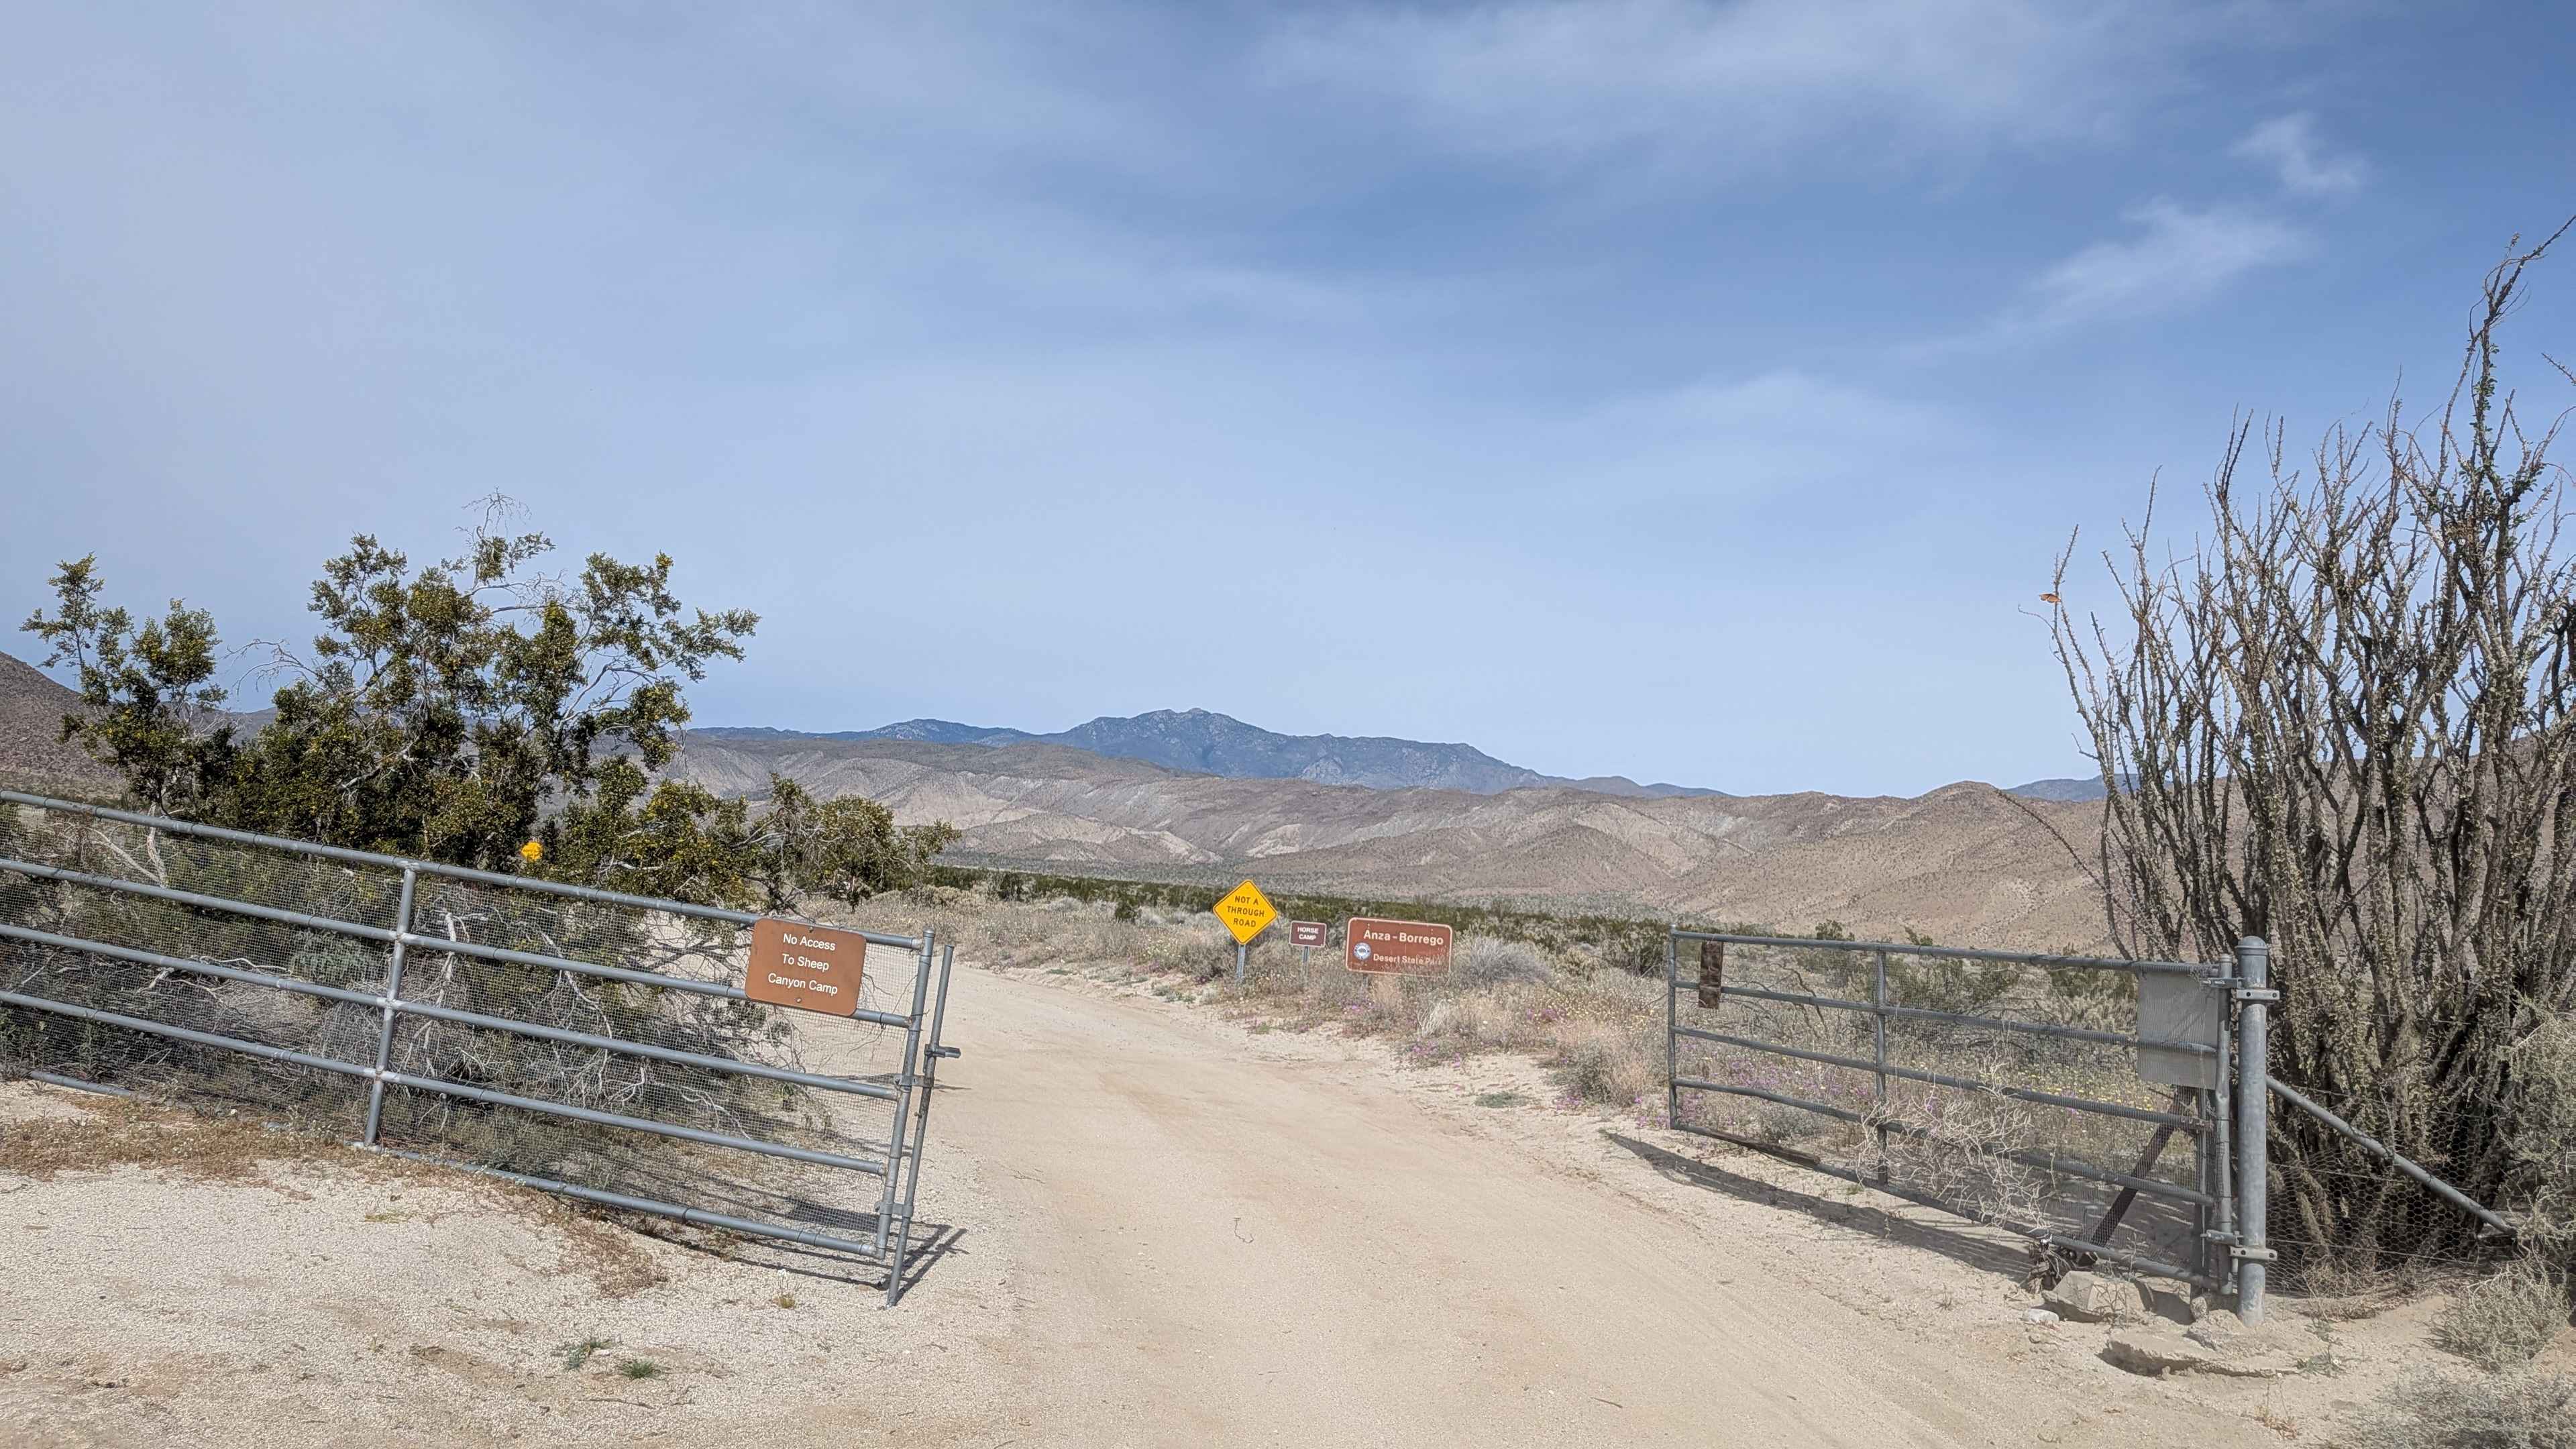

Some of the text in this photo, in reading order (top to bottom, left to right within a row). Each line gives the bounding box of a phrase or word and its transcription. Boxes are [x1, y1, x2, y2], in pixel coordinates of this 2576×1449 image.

[1234, 896, 1250, 904] NOT
[1227, 906, 1265, 918] THROUGH
[1233, 918, 1256, 928] ROAD
[1297, 926, 1319, 934] HORSE
[783, 933, 836, 951] No Access
[782, 953, 830, 973] To Sheep
[1373, 953, 1401, 963] Desert
[768, 973, 838, 996] Canyon Camp
